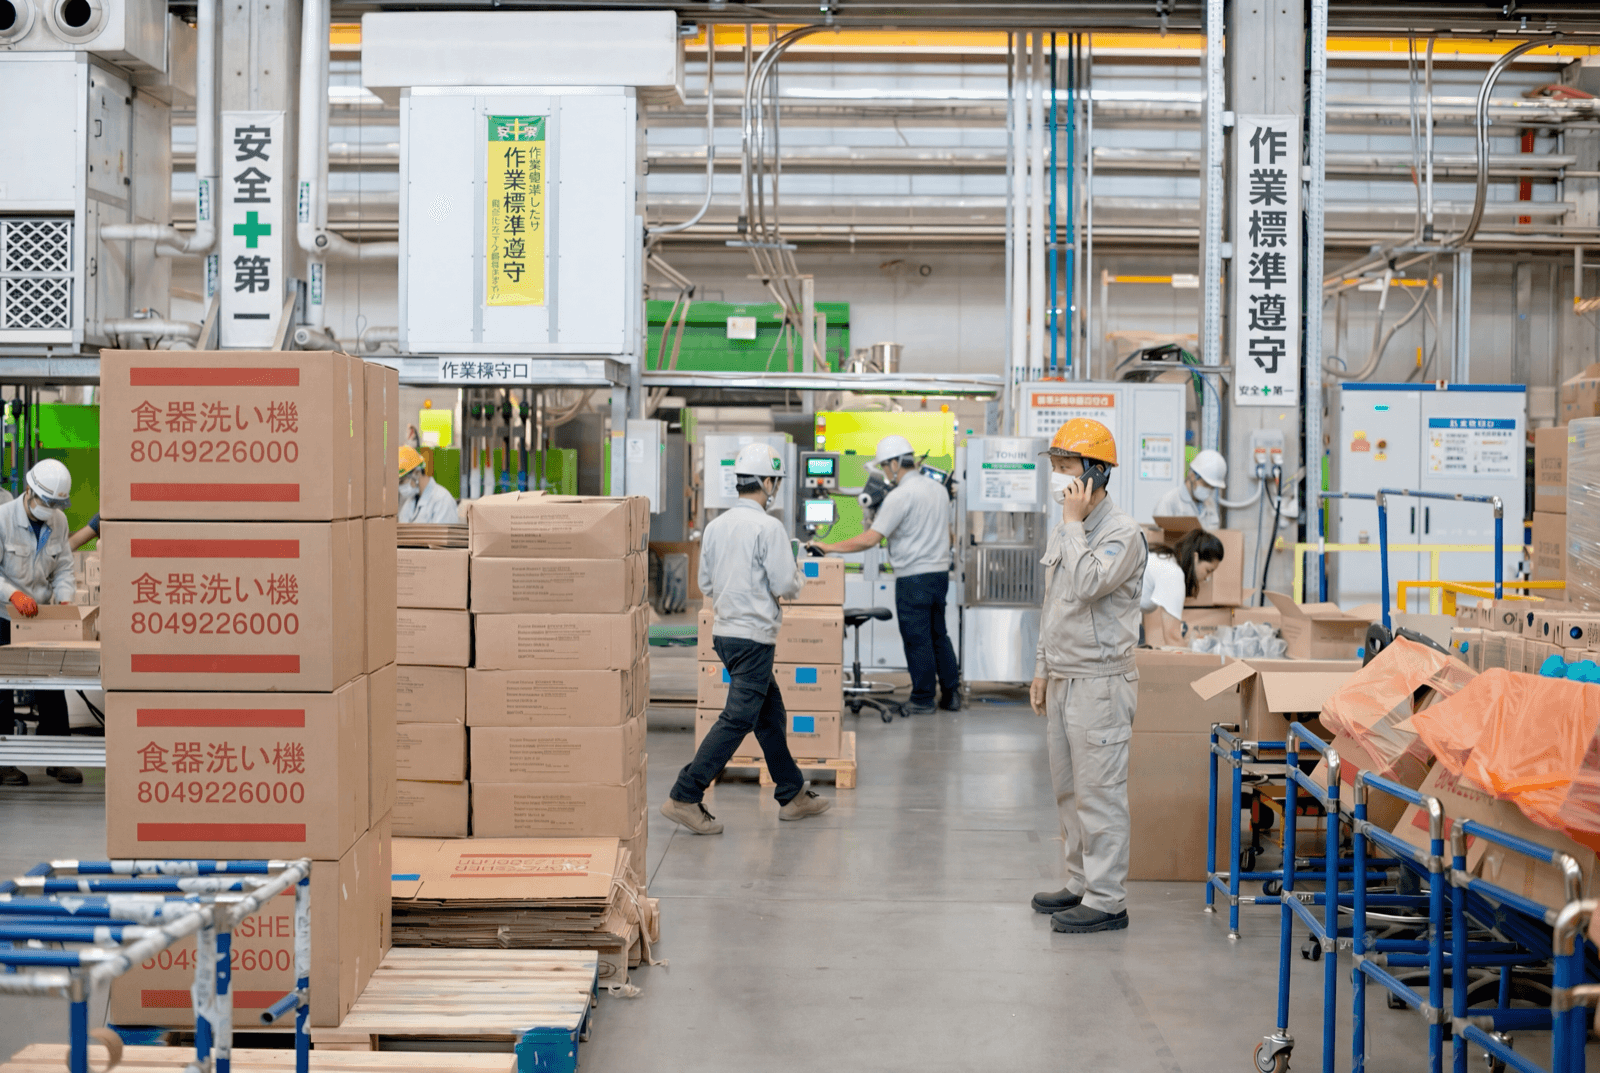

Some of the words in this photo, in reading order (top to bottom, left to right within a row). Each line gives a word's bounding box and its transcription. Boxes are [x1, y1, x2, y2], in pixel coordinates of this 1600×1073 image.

[502, 146, 527, 283] 作業標準遵守
[1248, 126, 1288, 374] 作業標準遵守
[130, 400, 299, 433] 食器洗い機
[130, 440, 299, 463] 8049226000
[131, 572, 299, 605] 食器洗い機
[131, 612, 299, 635] 8049226000
[137, 741, 305, 774] 食器洗い機
[137, 781, 305, 804] 8049226000
